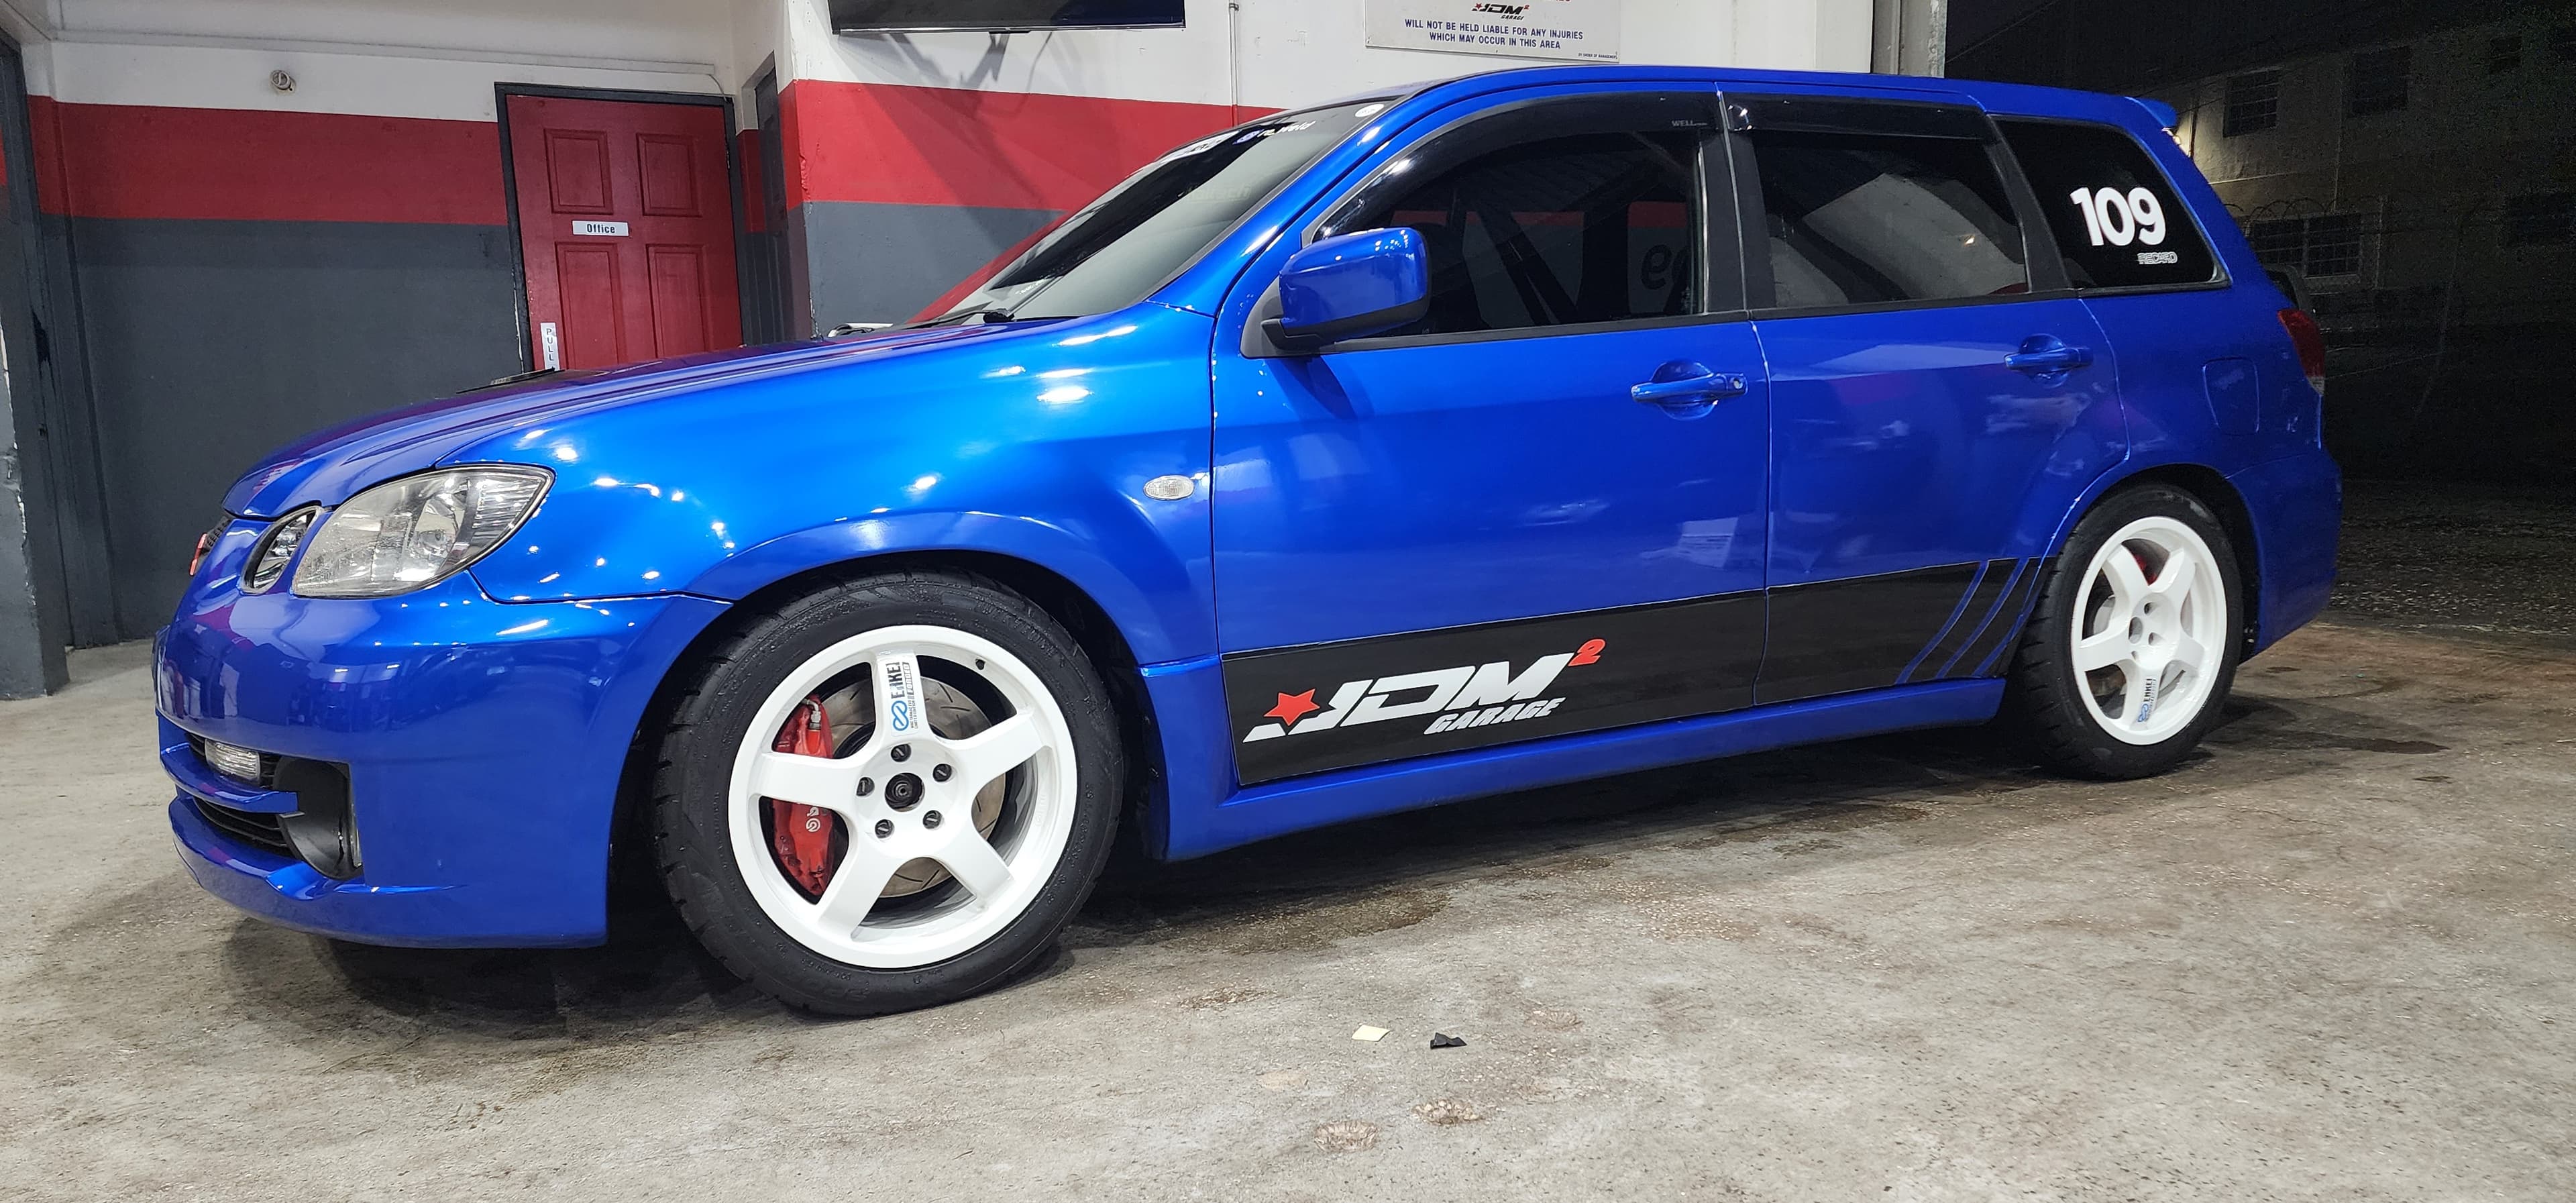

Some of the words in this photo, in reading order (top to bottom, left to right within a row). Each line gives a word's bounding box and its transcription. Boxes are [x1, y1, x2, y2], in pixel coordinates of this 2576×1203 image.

[1405, 19, 1423, 28] WILL
[1427, 21, 1442, 30] NOT
[1446, 22, 1456, 31] BE
[1460, 23, 1479, 32] HELD
[1483, 25, 1509, 34] LIABLE
[1512, 27, 1527, 36] FOR
[1531, 28, 1546, 37] ANY
[1550, 30, 1583, 40] INJURIES
[1430, 32, 1456, 42] WHICH
[1459, 34, 1475, 43] MAY
[1479, 36, 1505, 45] OCCUR
[1519, 38, 1536, 47] THIS
[1540, 40, 1561, 49] AREA
[2070, 187, 2166, 246] 109
[587, 223, 615, 233] Office
[2137, 252, 2178, 264] RECARO
[546, 328, 554, 361] PULL
[2143, 678, 2152, 702] ENKEI
[1424, 697, 1566, 735] GARAGE
